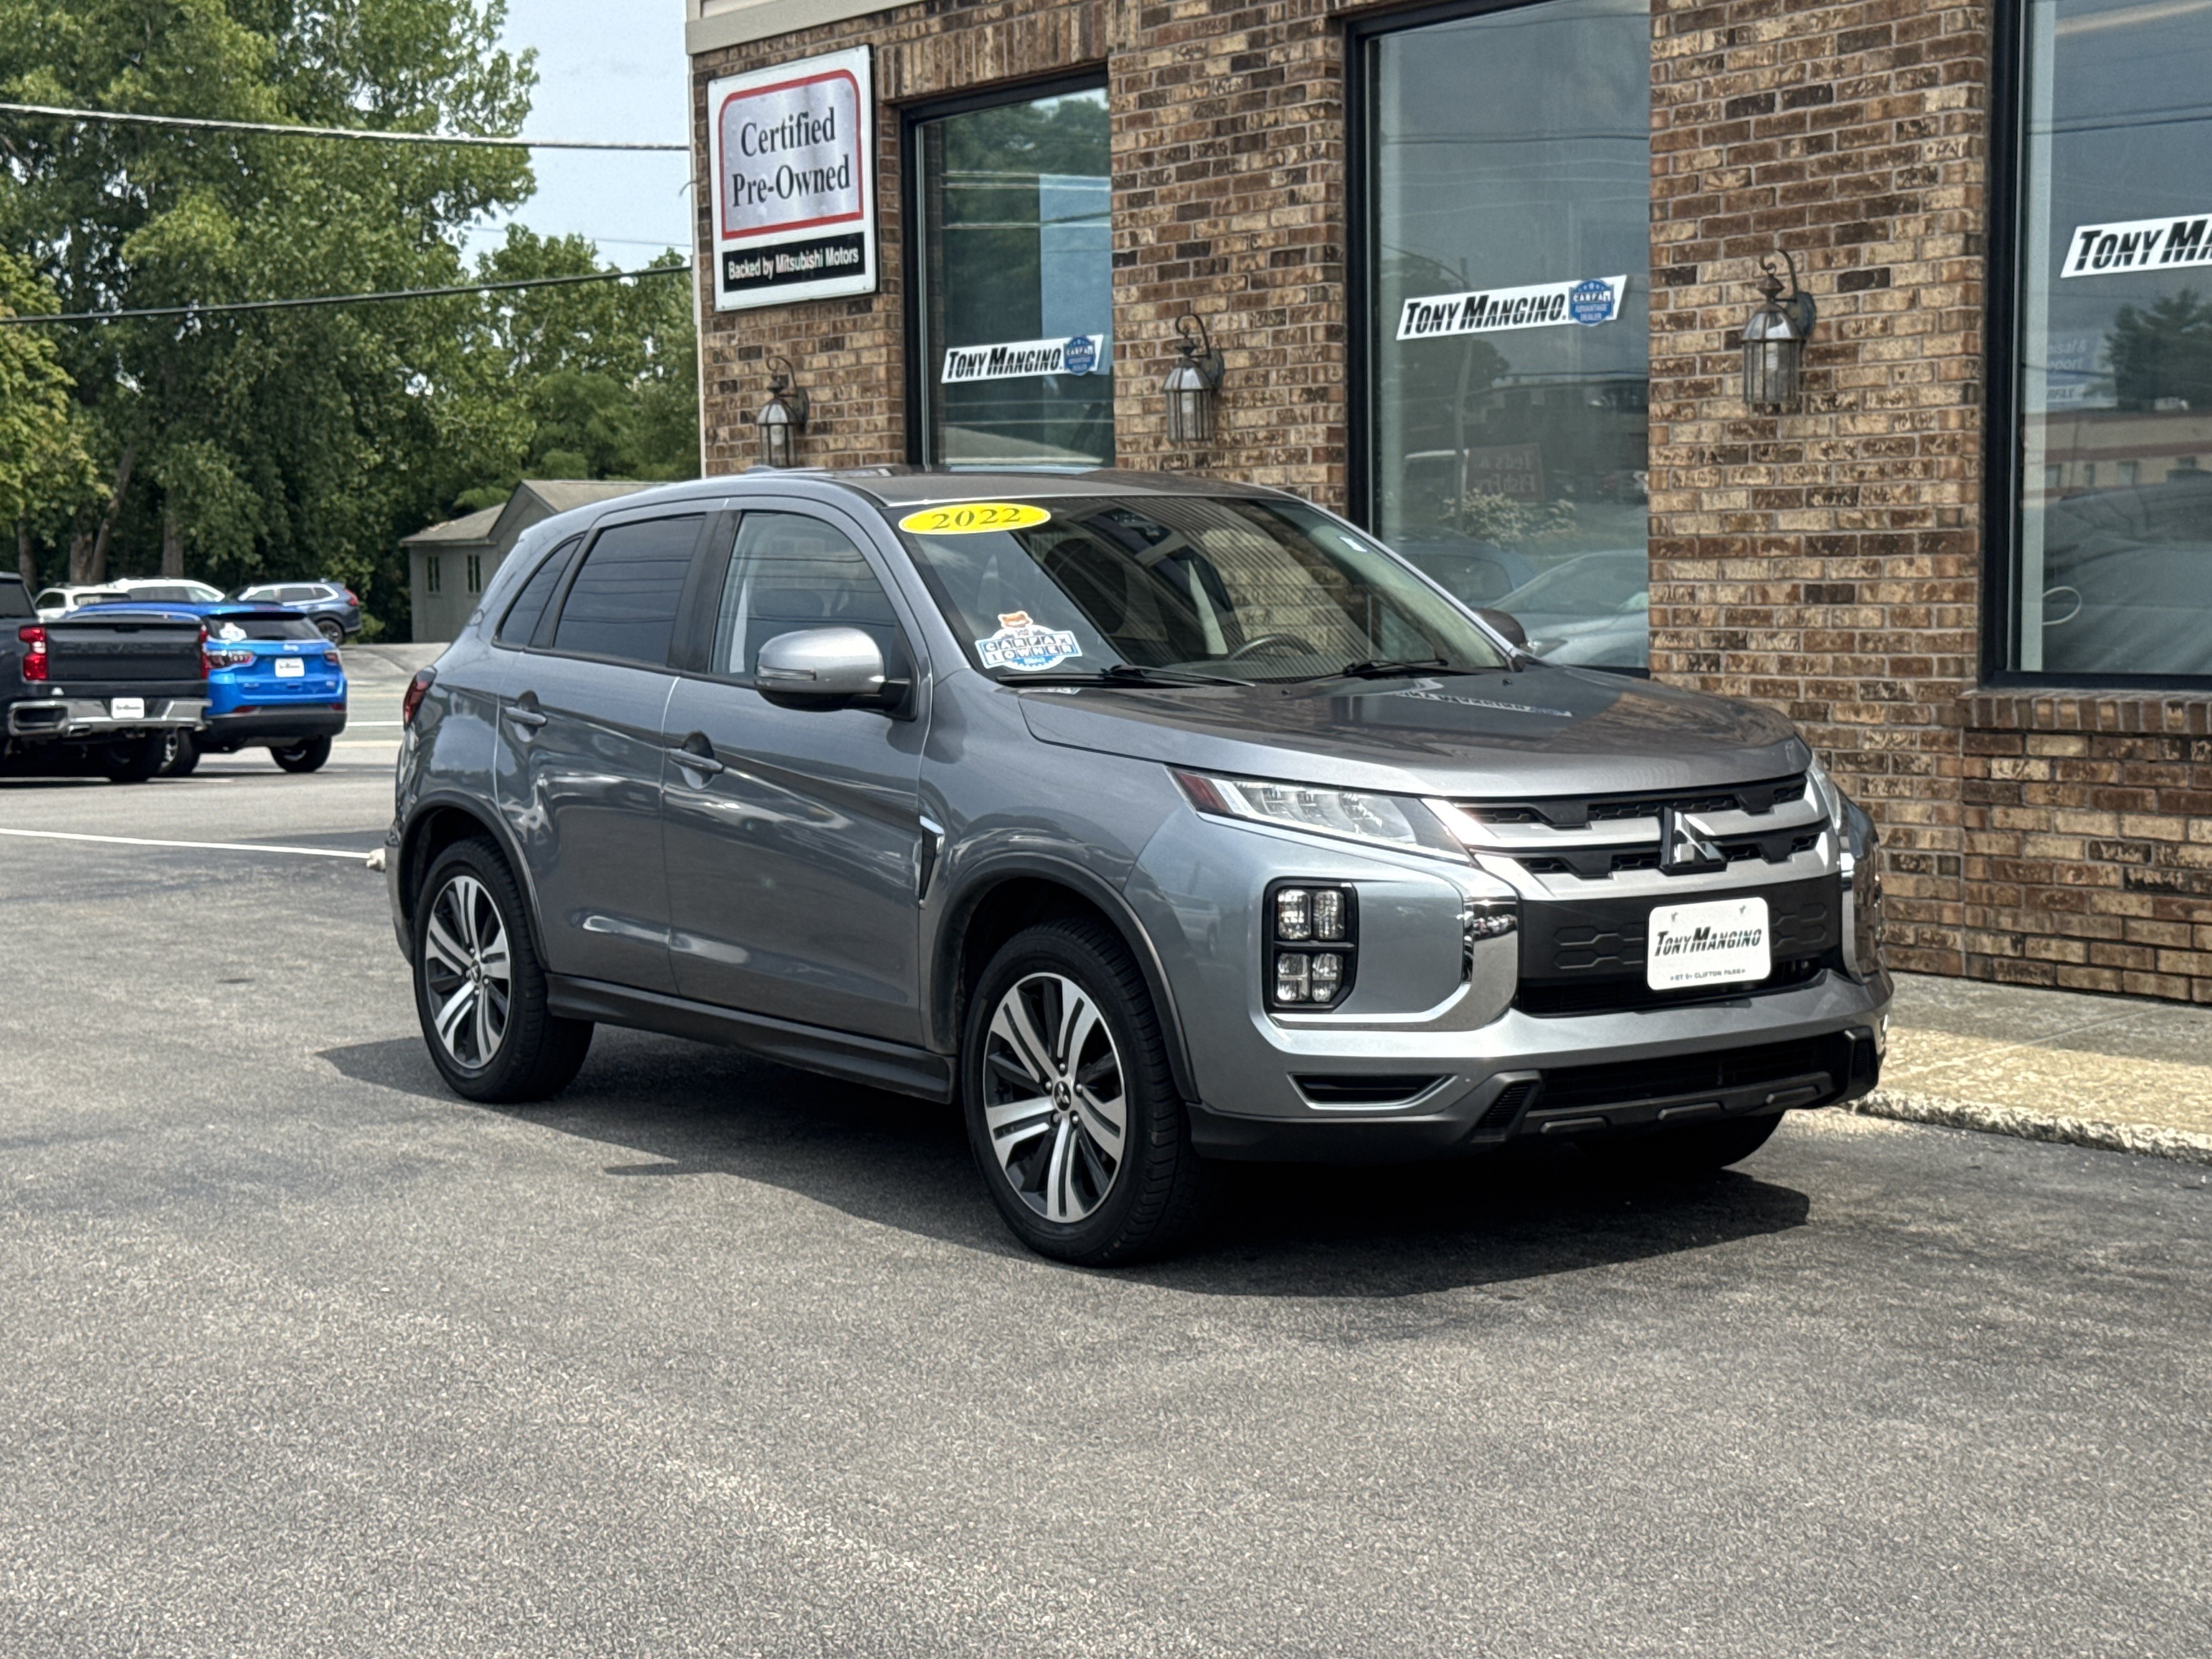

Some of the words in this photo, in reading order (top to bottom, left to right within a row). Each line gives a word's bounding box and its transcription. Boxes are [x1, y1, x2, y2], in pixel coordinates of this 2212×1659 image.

[741, 106, 836, 157] Certified
[732, 153, 850, 207] Pre-Owned
[728, 258, 761, 280] Backed
[762, 256, 774, 280] by
[775, 248, 823, 274] Mitsubishi
[825, 246, 859, 267] Motors
[2074, 228, 2164, 272] TONY
[1403, 302, 1461, 335] TONY
[947, 351, 988, 379] TONY
[931, 507, 1022, 531] 2022
[985, 635, 1067, 652] CARFAX
[1003, 645, 1073, 658] OWNER
[1654, 930, 1692, 957] TONY
[1689, 926, 1762, 953] MANGINO
